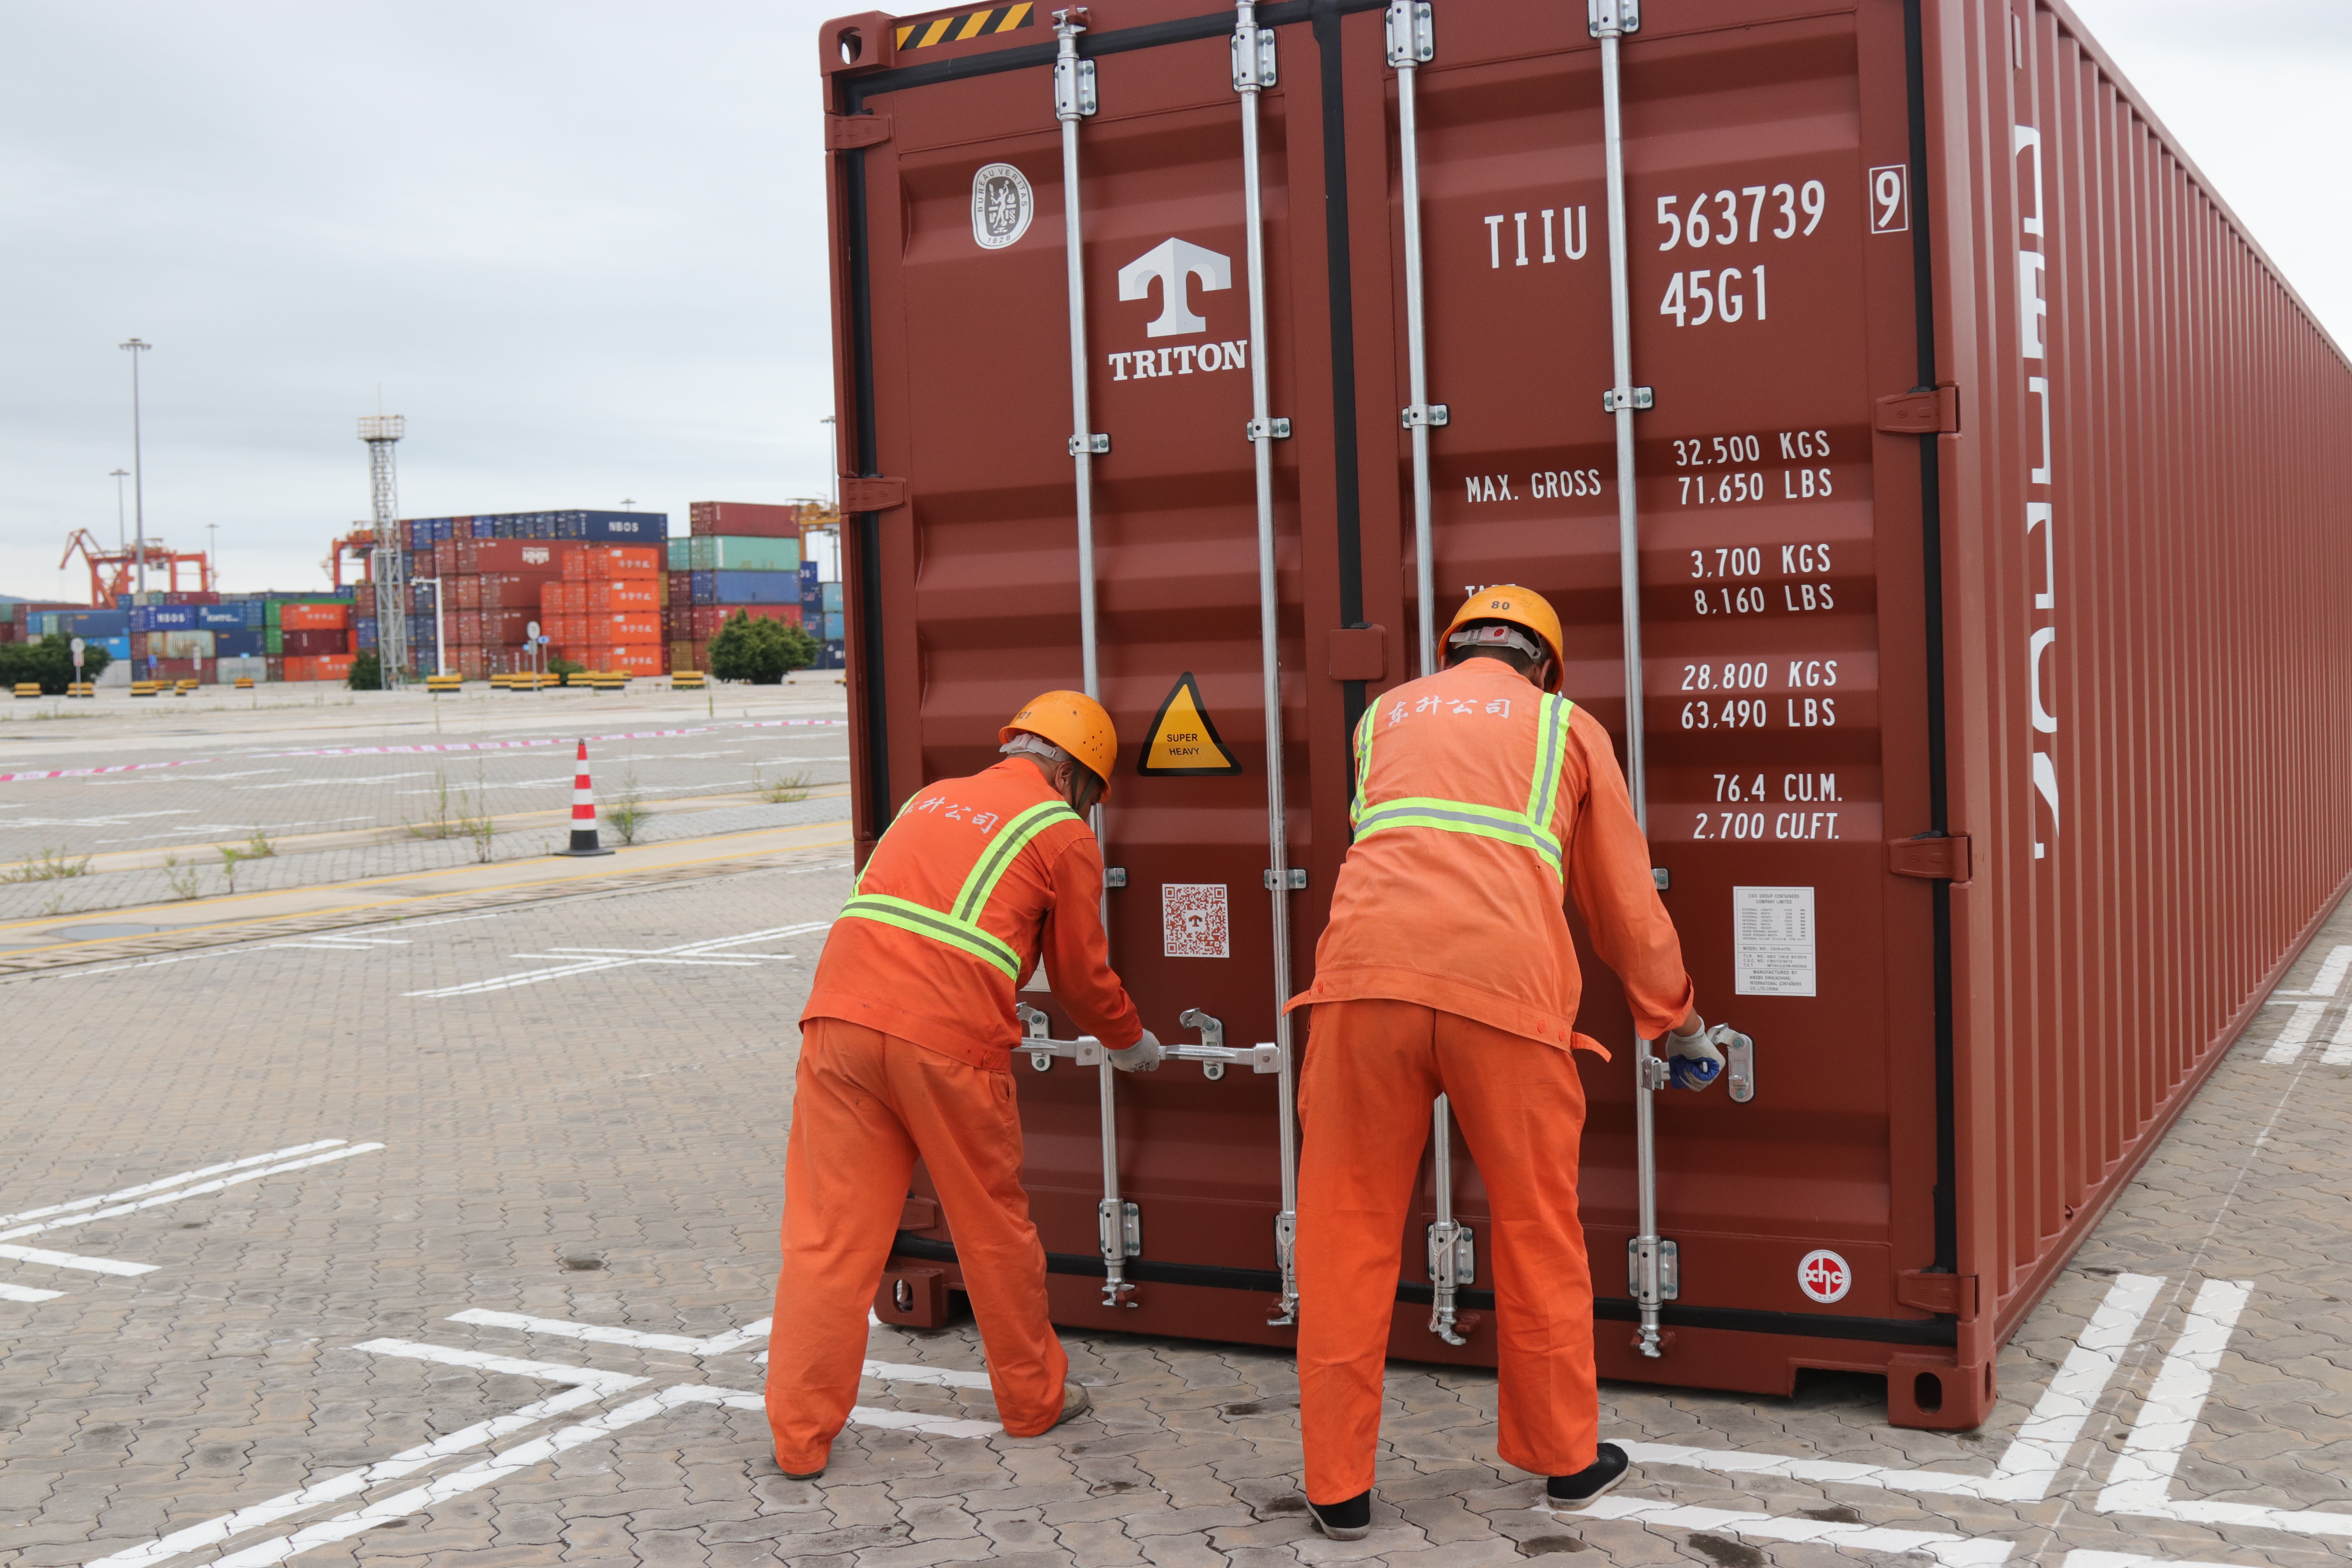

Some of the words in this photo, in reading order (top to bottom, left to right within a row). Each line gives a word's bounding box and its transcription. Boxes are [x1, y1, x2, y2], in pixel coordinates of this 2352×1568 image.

[978, 169, 995, 212] BUREAU
[998, 168, 1027, 207] VERITAS
[1485, 205, 1587, 269] TIIU
[1657, 180, 1825, 251] 563739
[1876, 170, 1900, 228] 9
[987, 235, 1011, 243] 1828
[1660, 264, 1766, 327] 45G1
[1109, 339, 1247, 381] TRITON
[1673, 435, 1760, 466] 32,500
[1780, 430, 1830, 459] KGS
[1465, 475, 1519, 503] MAX.
[1532, 469, 1602, 499] GROSS
[1678, 472, 1763, 505] 71,650
[1784, 468, 1832, 499] LBS
[1691, 547, 1760, 578] 3,700
[1782, 543, 1831, 574] KGS
[1491, 601, 1510, 610] 80
[1695, 587, 1764, 615] 8,160
[1784, 583, 1834, 612] LBS
[1682, 662, 1768, 690] 28,800
[1788, 660, 1837, 687] KGS
[1388, 695, 1511, 727] 东升公司
[1682, 699, 1766, 729] 63,490
[1788, 698, 1836, 727] LBS
[1167, 733, 1198, 742] SUPER
[1713, 774, 1765, 802] 76.4
[1784, 773, 1842, 802] CU.M.
[1693, 813, 1764, 839] 2,700
[1775, 813, 1840, 839] CU.FT.
